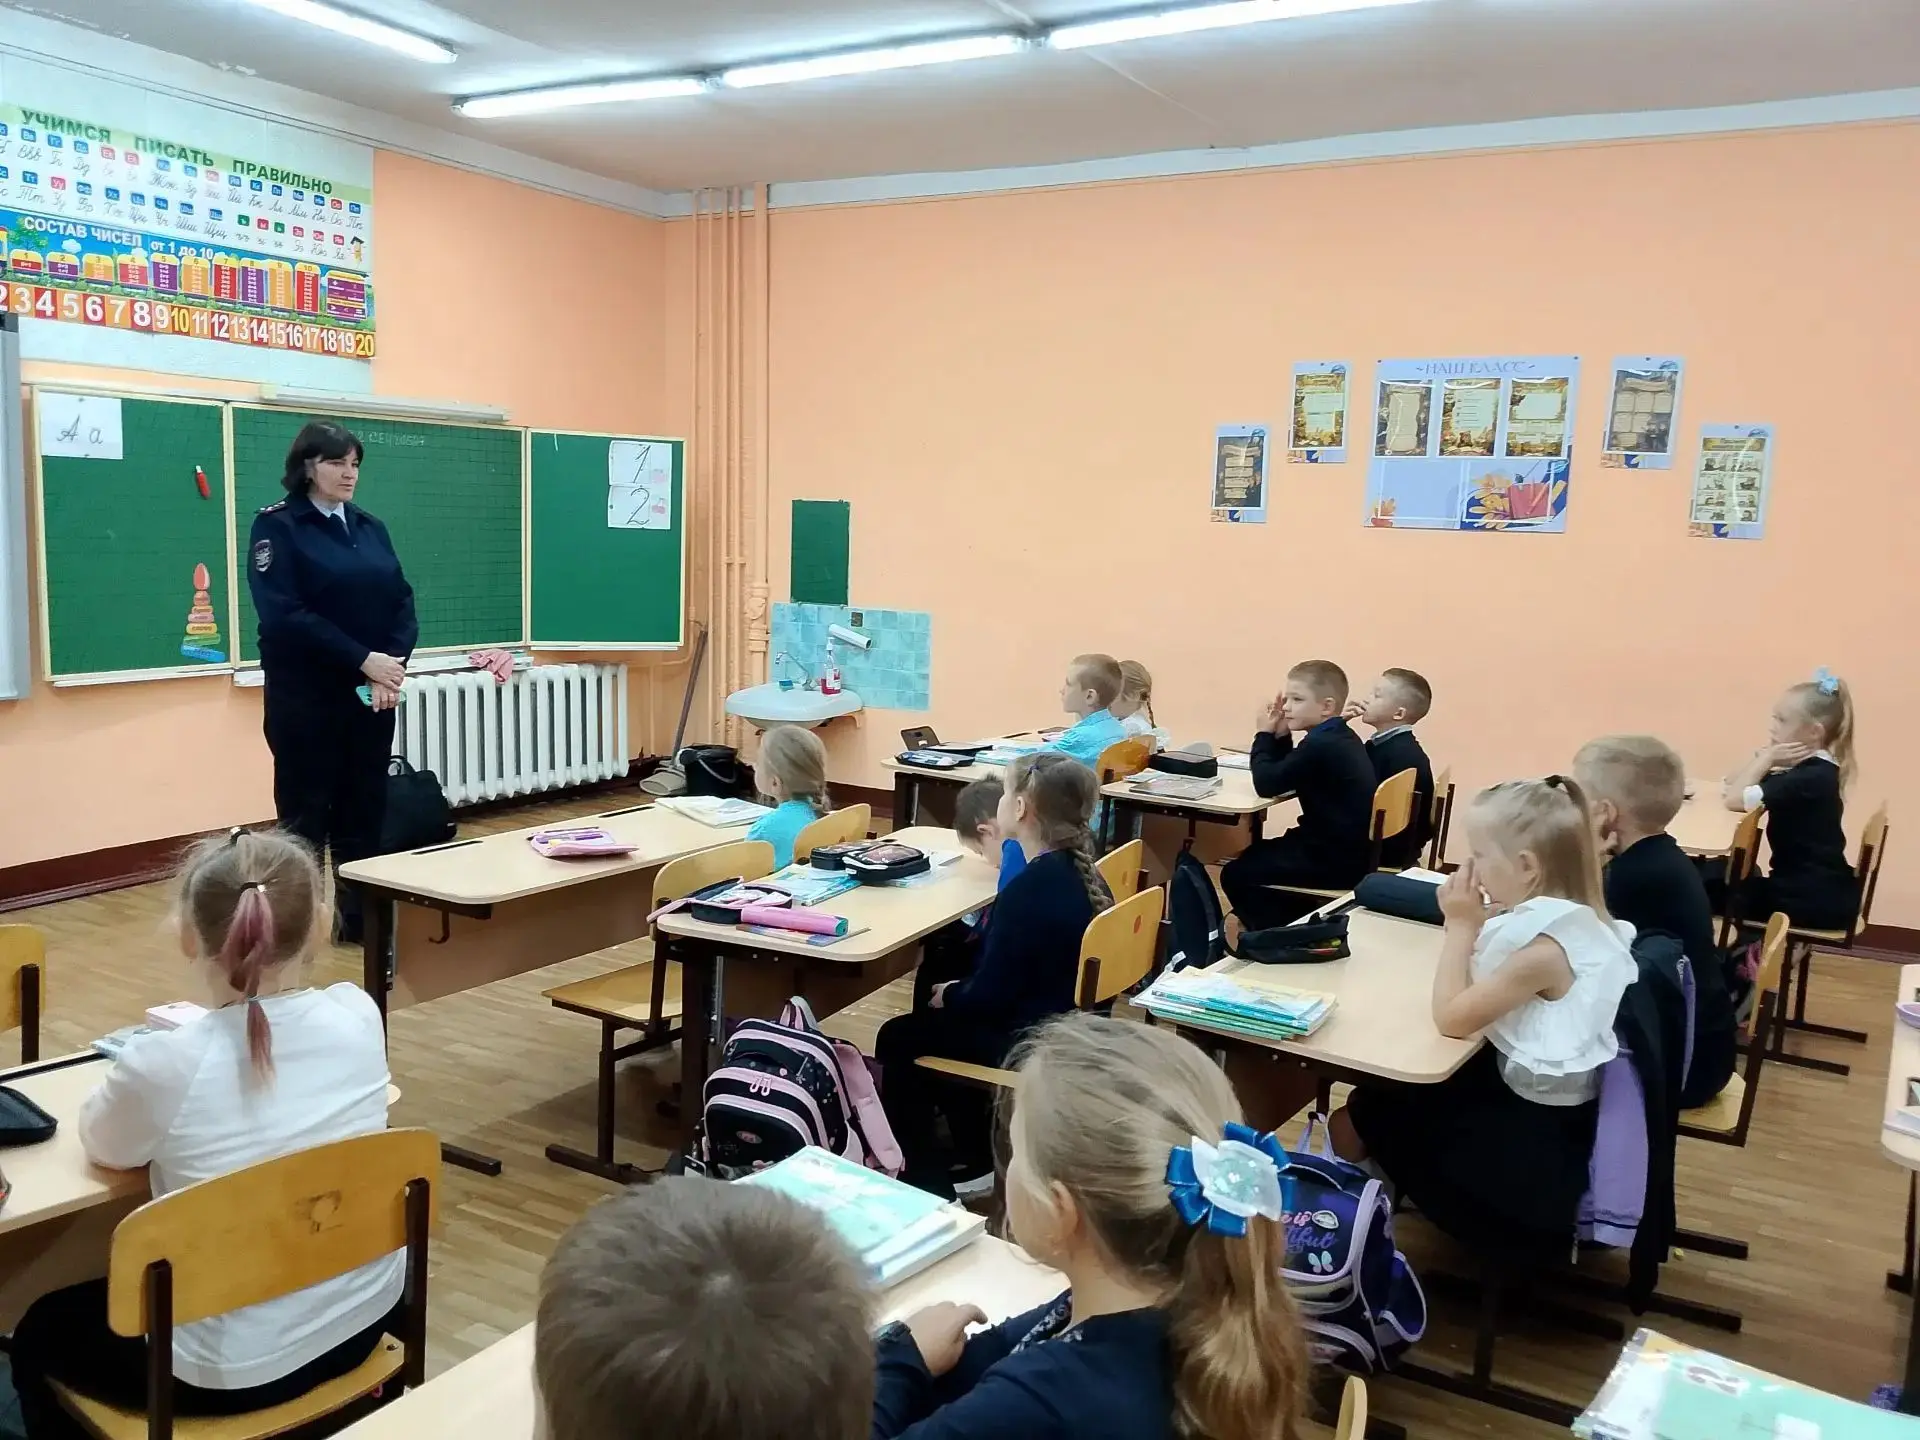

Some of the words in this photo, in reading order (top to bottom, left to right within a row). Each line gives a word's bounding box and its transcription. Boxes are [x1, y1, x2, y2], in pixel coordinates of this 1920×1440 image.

[22, 109, 112, 144] УЧИМСЯ
[134, 136, 214, 167] ПИСАТЬ
[232, 159, 333, 195] ПРАВИЛЬНО
[24, 216, 88, 239] СОСТАВ
[90, 227, 142, 247] ЧИСЕЛ
[151, 241, 166, 252] от
[168, 242, 176, 254] 1
[178, 246, 197, 258] до
[200, 247, 214, 260] 10
[14, 287, 31, 313] 3
[35, 290, 55, 317] 4
[62, 293, 79, 318] 5
[85, 296, 104, 322] 6
[109, 299, 127, 323] 7
[133, 302, 151, 327] 8
[155, 305, 169, 329] 9
[170, 307, 190, 333] 10
[192, 311, 208, 335] 11
[211, 313, 230, 338] 12
[230, 316, 249, 340] 13
[250, 319, 269, 343] 14
[269, 321, 286, 345] 15
[286, 324, 303, 348] 16
[303, 327, 320, 349] 17
[320, 329, 337, 352] 18
[338, 332, 355, 354] 19
[355, 334, 375, 357] 20
[1426, 362, 1464, 374] НАШ
[635, 445, 651, 484] 1
[626, 487, 650, 525] 2
